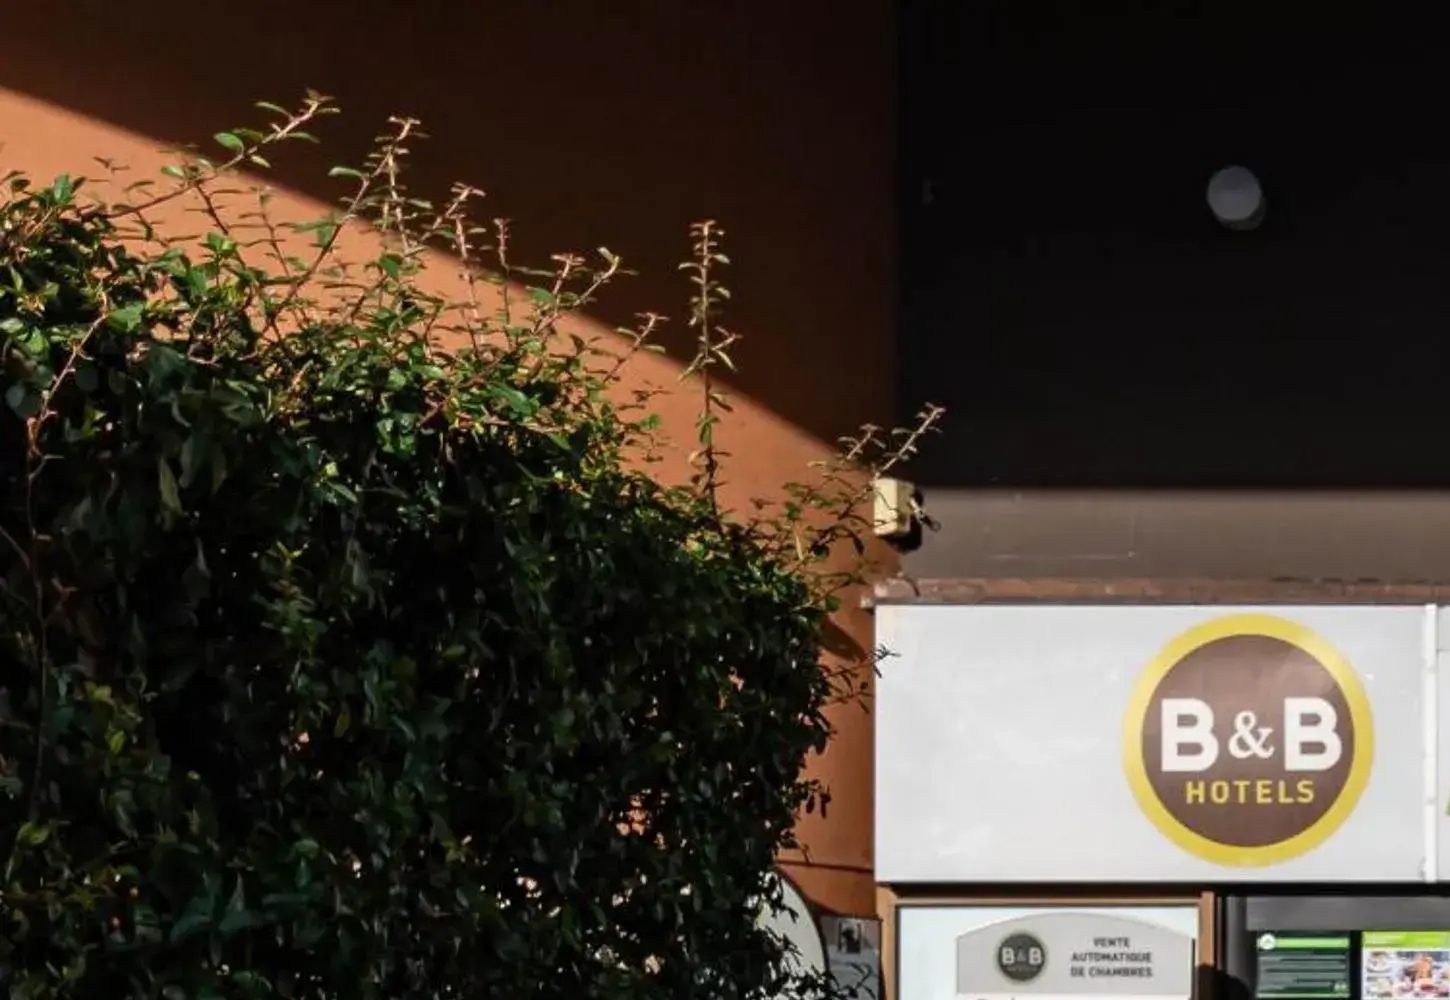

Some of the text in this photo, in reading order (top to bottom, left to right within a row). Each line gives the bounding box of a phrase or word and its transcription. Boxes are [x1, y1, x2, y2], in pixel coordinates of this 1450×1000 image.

[1160, 696, 1343, 773] B&B
[1184, 779, 1316, 805] HOTELS
[1093, 937, 1131, 948] VENTE
[1071, 952, 1152, 964] AUTOMATIQUE
[1070, 967, 1153, 978] DE CHAMBRES
